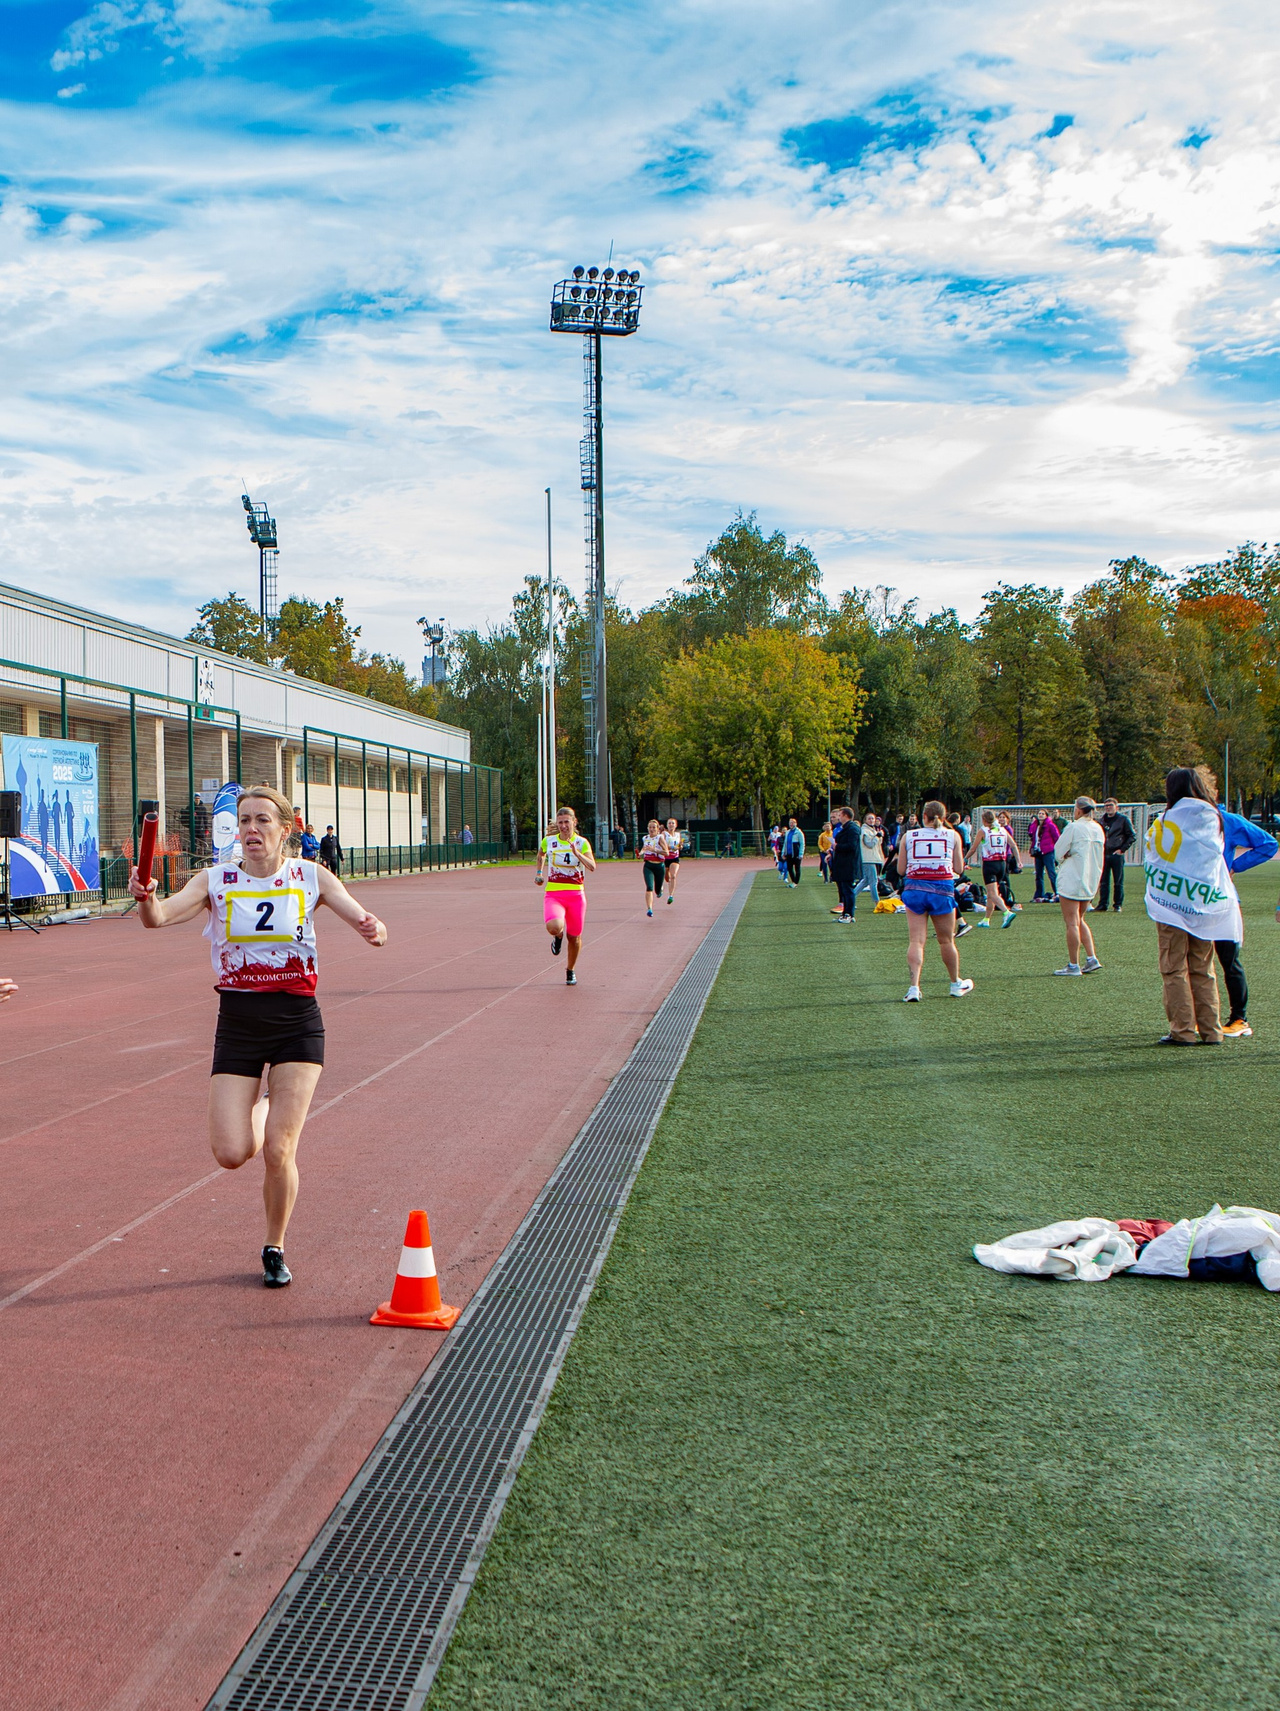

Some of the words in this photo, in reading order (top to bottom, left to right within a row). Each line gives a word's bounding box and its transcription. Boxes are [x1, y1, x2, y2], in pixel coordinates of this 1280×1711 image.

[52, 765, 73, 781] 2025
[925, 842, 933, 855] 1
[563, 853, 571, 865] 4
[255, 901, 275, 932] 2
[296, 925, 304, 942] 3
